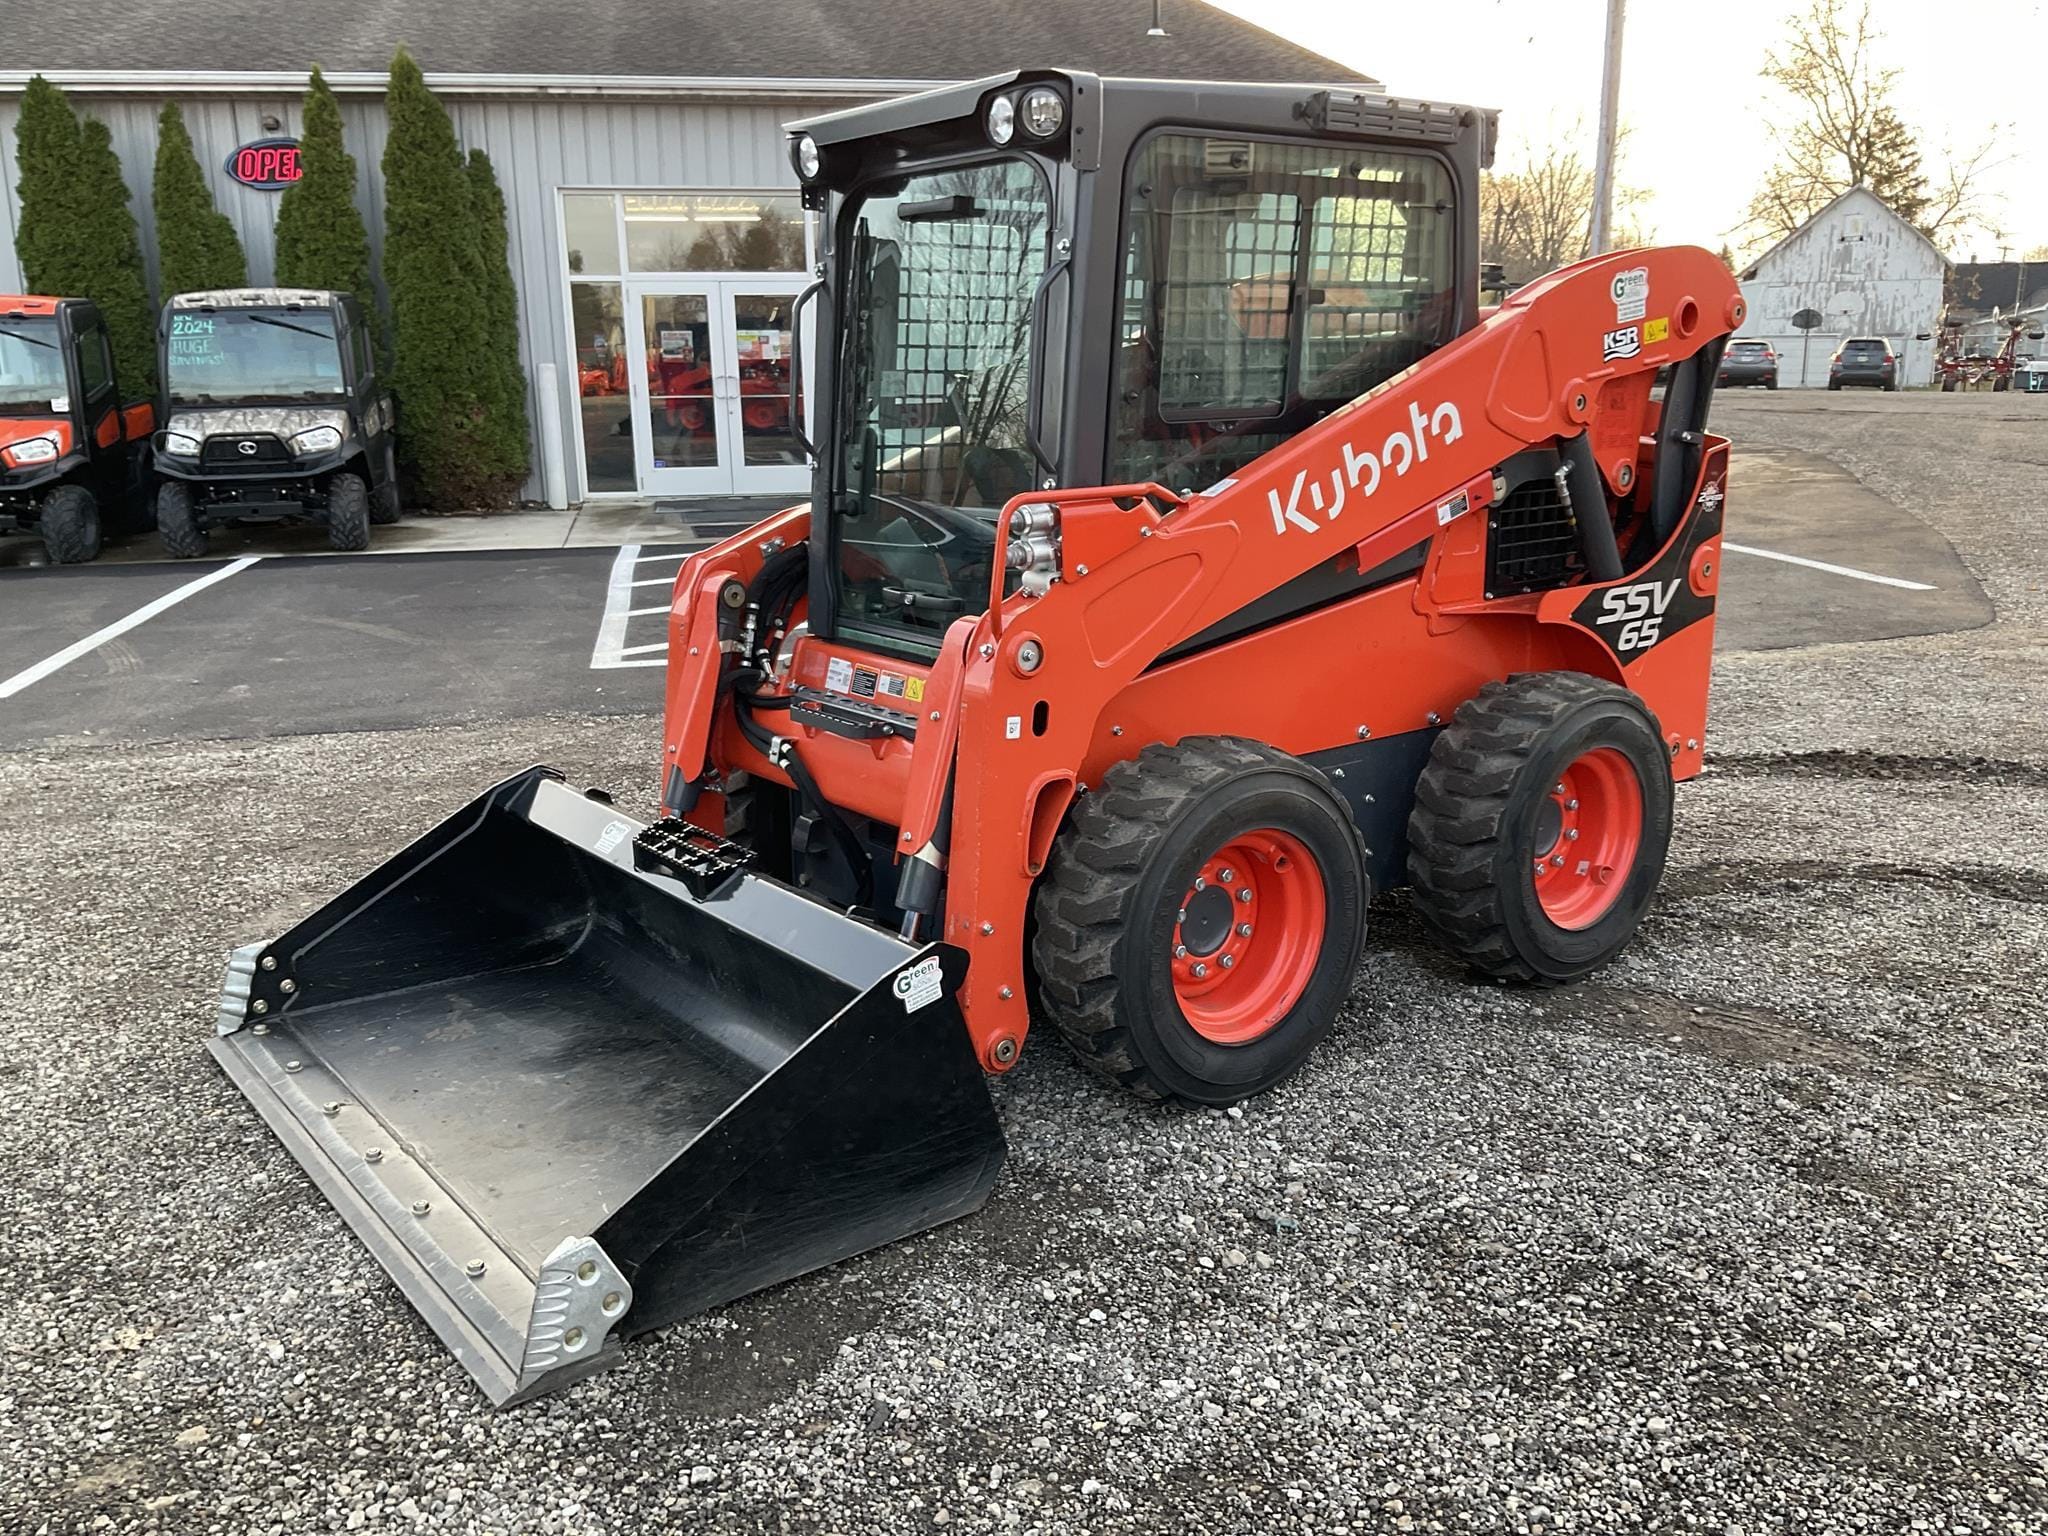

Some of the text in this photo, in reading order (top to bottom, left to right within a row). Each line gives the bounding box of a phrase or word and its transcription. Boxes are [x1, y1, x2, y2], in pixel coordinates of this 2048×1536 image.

[173, 319, 216, 334] 2024
[1604, 326, 1638, 350] KSR
[173, 339, 212, 354] HUGE
[1267, 401, 1463, 535] Kubota
[1596, 578, 1681, 624] SSV
[1618, 617, 1662, 651] 65
[897, 963, 934, 994] Green
